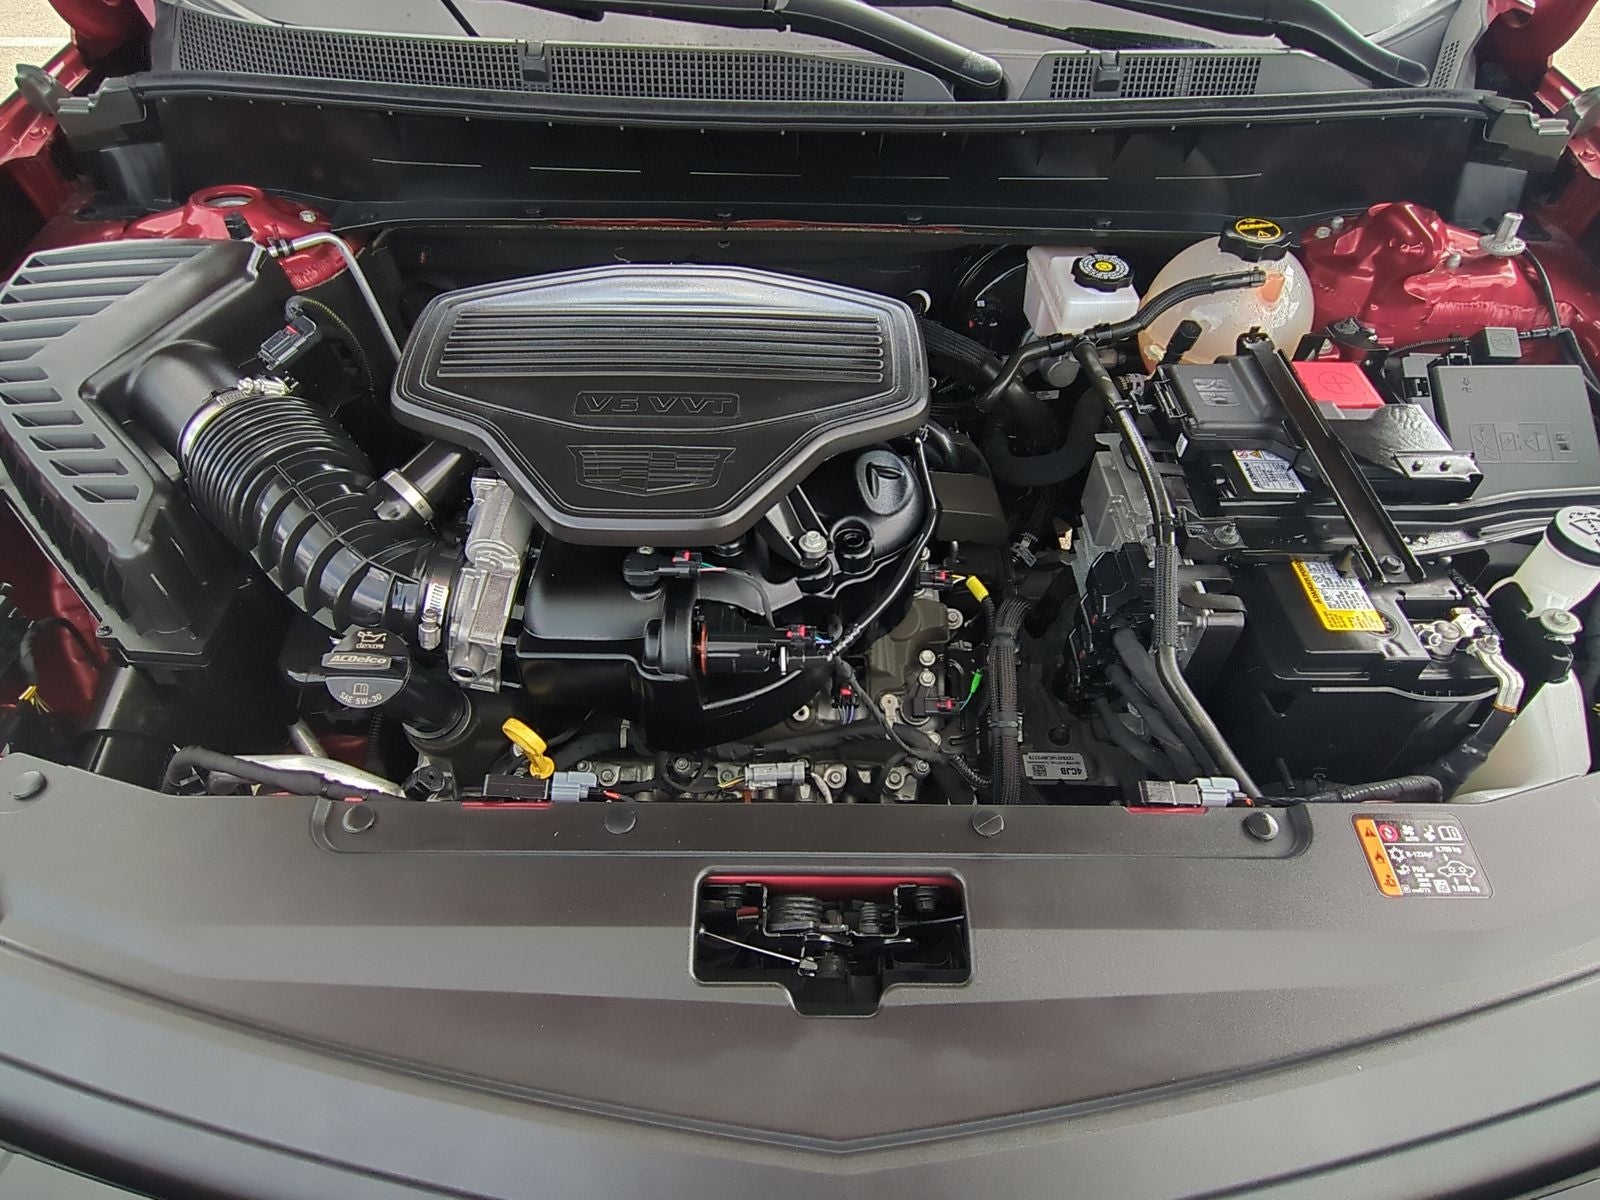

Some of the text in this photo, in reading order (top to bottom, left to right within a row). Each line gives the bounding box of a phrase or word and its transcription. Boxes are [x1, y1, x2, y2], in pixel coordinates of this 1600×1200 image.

[583, 396, 733, 414] V6 VVT
[356, 642, 384, 650] dexos
[330, 655, 387, 664] ACDelco
[340, 692, 383, 705] SAE 5W-30
[1060, 767, 1082, 775] 4CJB
